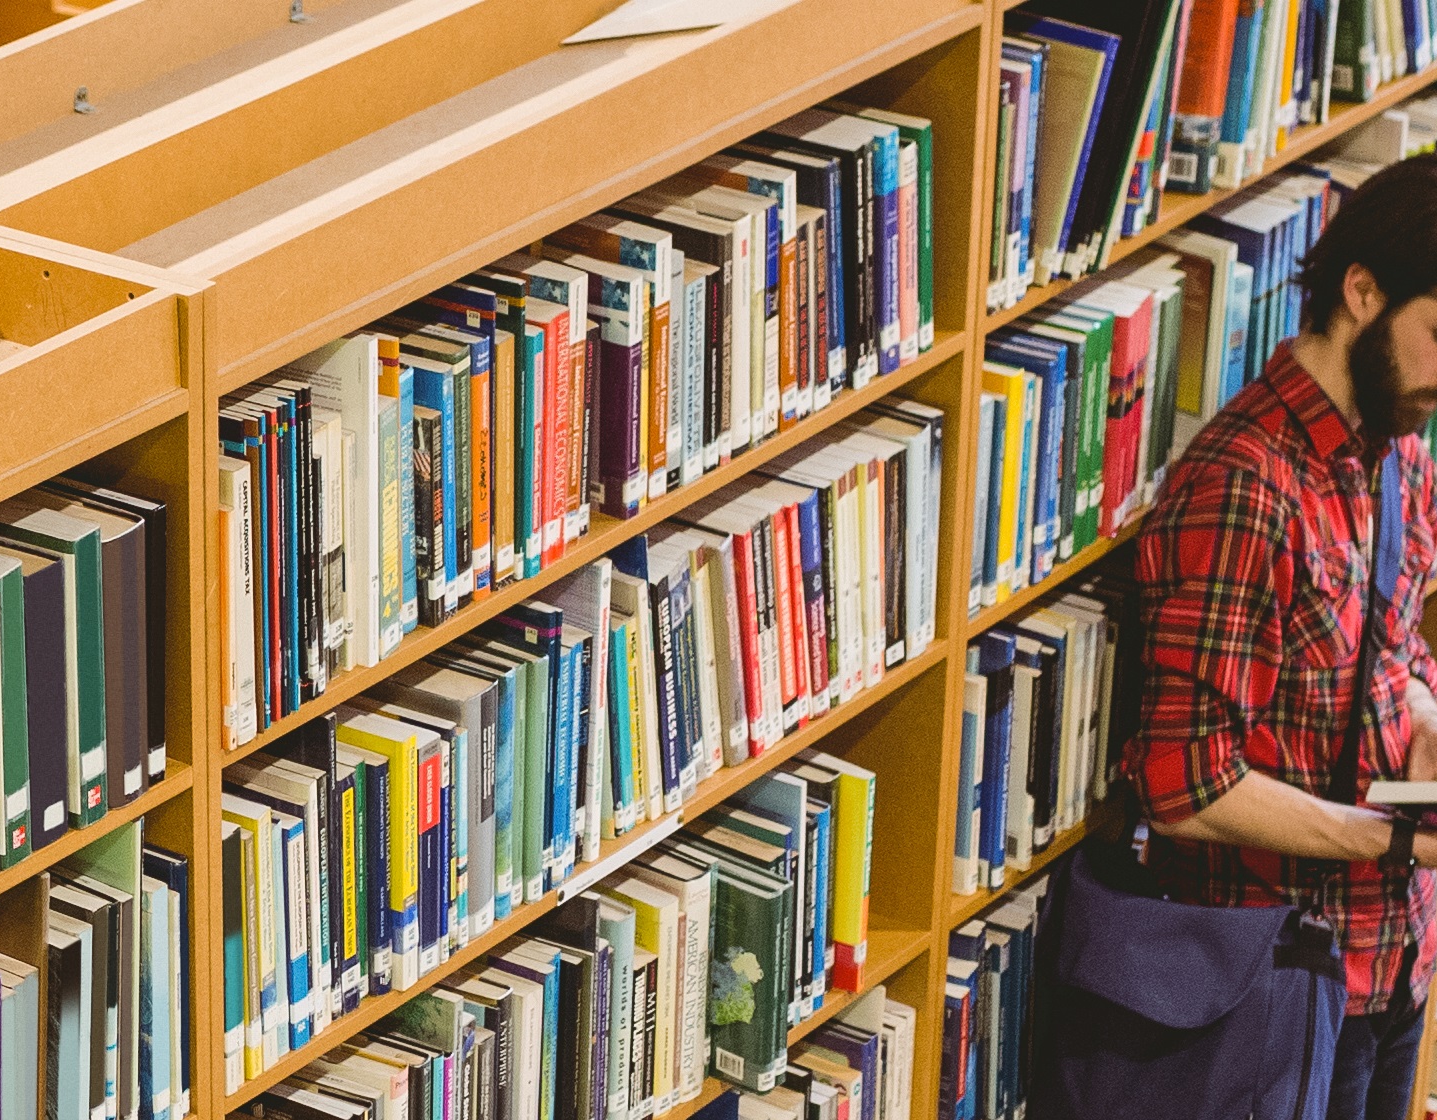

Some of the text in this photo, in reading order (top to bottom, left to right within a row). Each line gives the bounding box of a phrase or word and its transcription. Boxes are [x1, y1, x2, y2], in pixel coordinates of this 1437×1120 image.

[659, 326, 668, 443] International Economics
[670, 318, 680, 426] The Regional World
[554, 317, 569, 517] INTERNATIONAL ECONOMICS
[571, 365, 581, 486] International Economics
[598, 607, 608, 709] Industrial Development
[661, 596, 677, 740] EUROPEAN BUSINESS
[344, 793, 352, 808] THE
[344, 811, 352, 852] ECONOMICS
[319, 827, 329, 947] EUROPEAN INTEGRATION
[345, 853, 351, 863] OF
[344, 882, 354, 918] EUROPEAN
[346, 920, 354, 954] UNION
[621, 965, 629, 1012] worlds
[621, 1018, 627, 1030] of
[631, 974, 645, 1062] TRADING PLACES
[646, 992, 656, 1031] MITI
[683, 920, 698, 1071] AMERICAN INDUSTRY
[499, 1020, 508, 1089] ENTERPRISE
